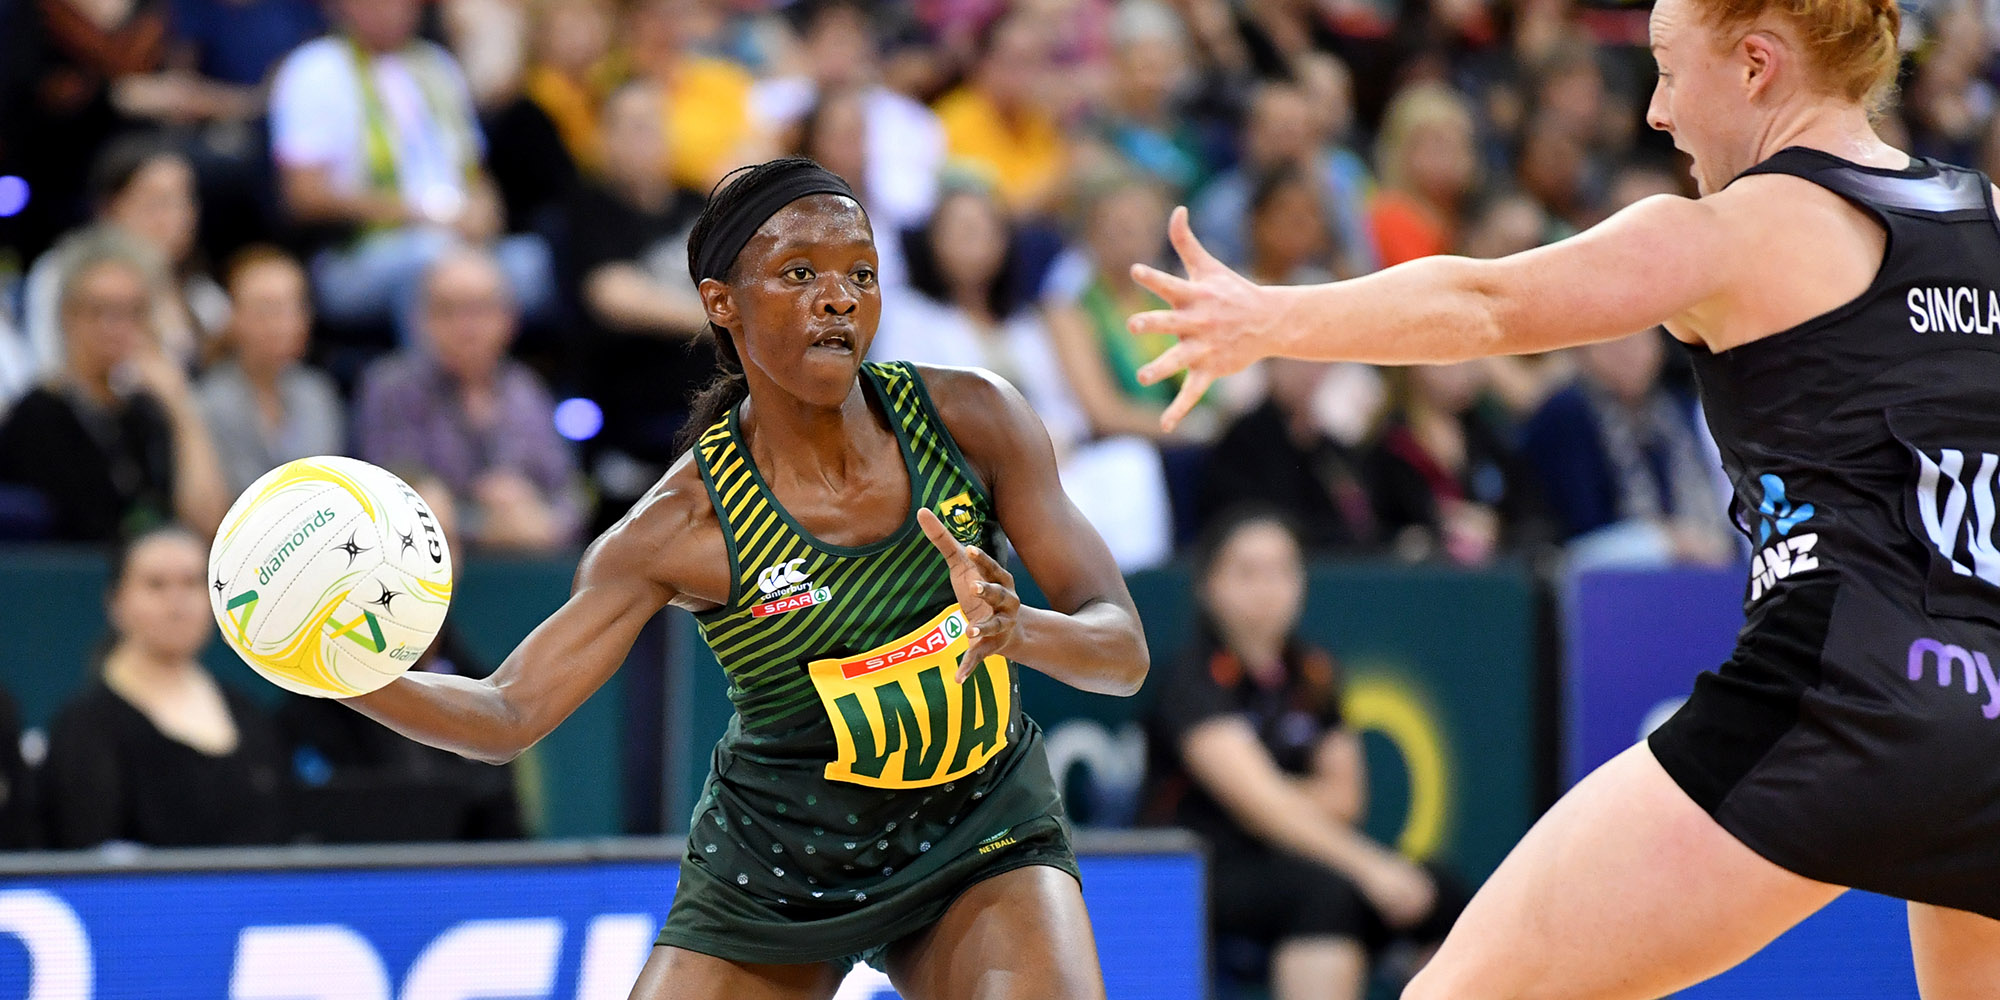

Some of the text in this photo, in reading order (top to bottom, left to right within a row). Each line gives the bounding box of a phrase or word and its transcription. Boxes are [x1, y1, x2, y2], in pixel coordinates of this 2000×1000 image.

[1907, 287, 2000, 335] SINCLA
[259, 507, 336, 586] diamonds
[1751, 532, 1819, 601] ANZ
[760, 581, 813, 601] canterbury
[764, 595, 812, 614] SPAR
[865, 632, 945, 669] SPAR
[833, 652, 999, 782] WA
[979, 837, 1017, 855] NETBALL
